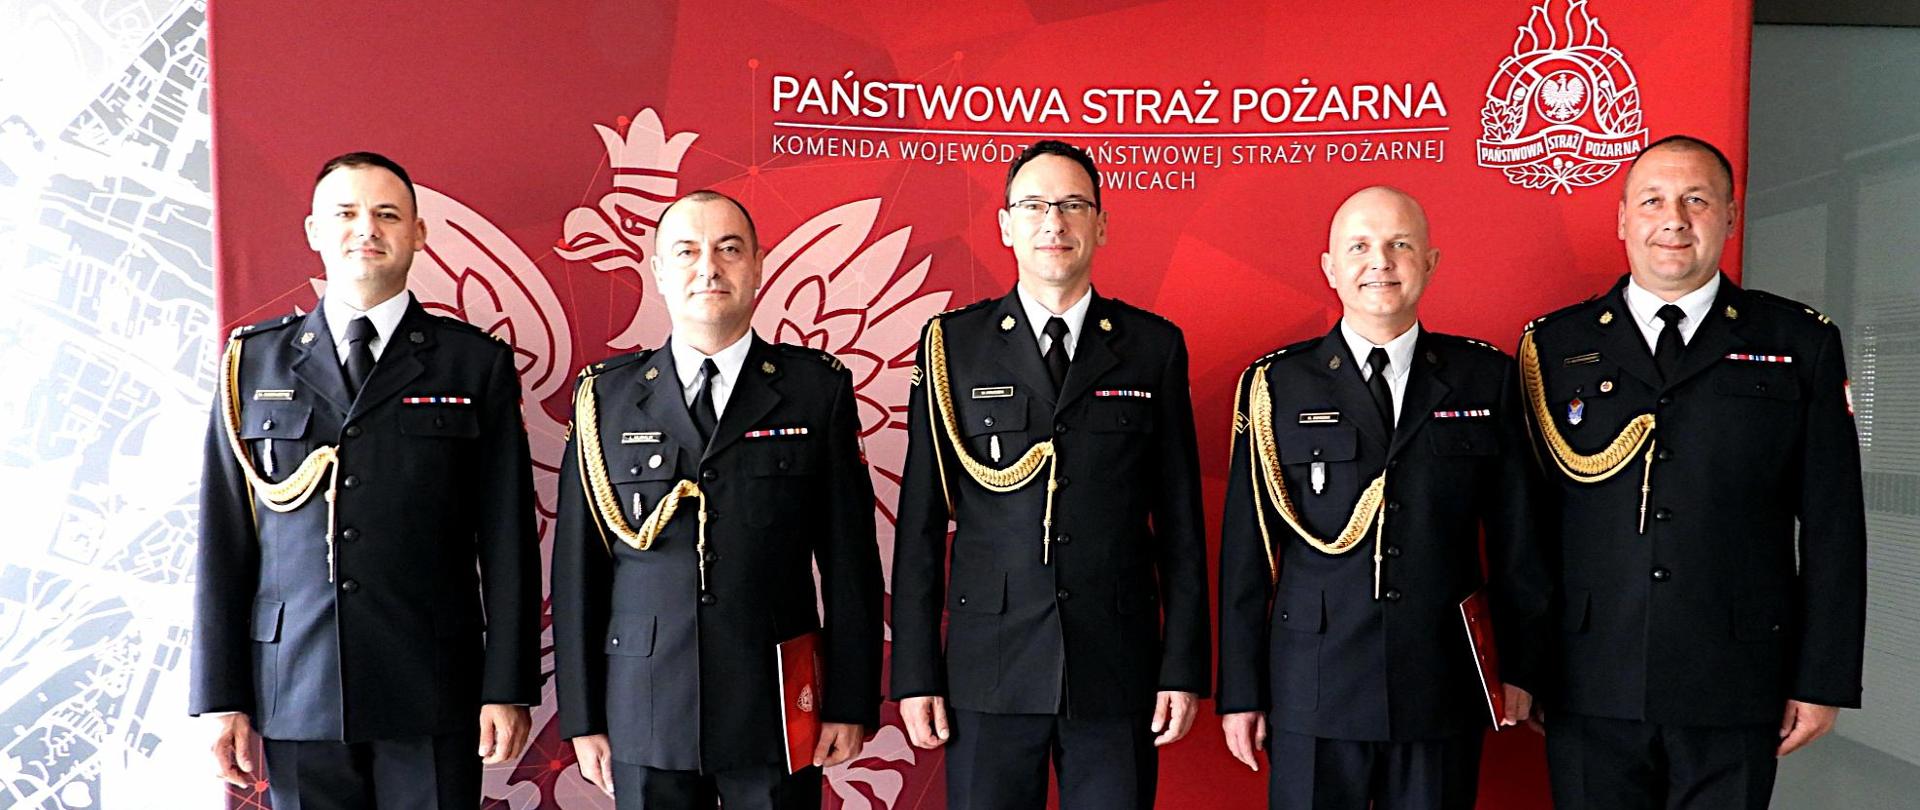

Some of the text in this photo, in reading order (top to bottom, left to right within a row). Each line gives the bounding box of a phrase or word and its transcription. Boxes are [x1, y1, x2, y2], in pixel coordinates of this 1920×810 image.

[772, 70, 1447, 124] PAŃSTWOWA STRAŻ POŻARNA
[773, 134, 890, 159] KOMENDA
[1071, 141, 1222, 168] AŃSTWOWEJ
[1232, 141, 1316, 164] STRAŻY
[1326, 139, 1444, 163] POŻARNEJ
[1481, 132, 1641, 162] PAŃSTWOWA STRAŻ POŻARNA
